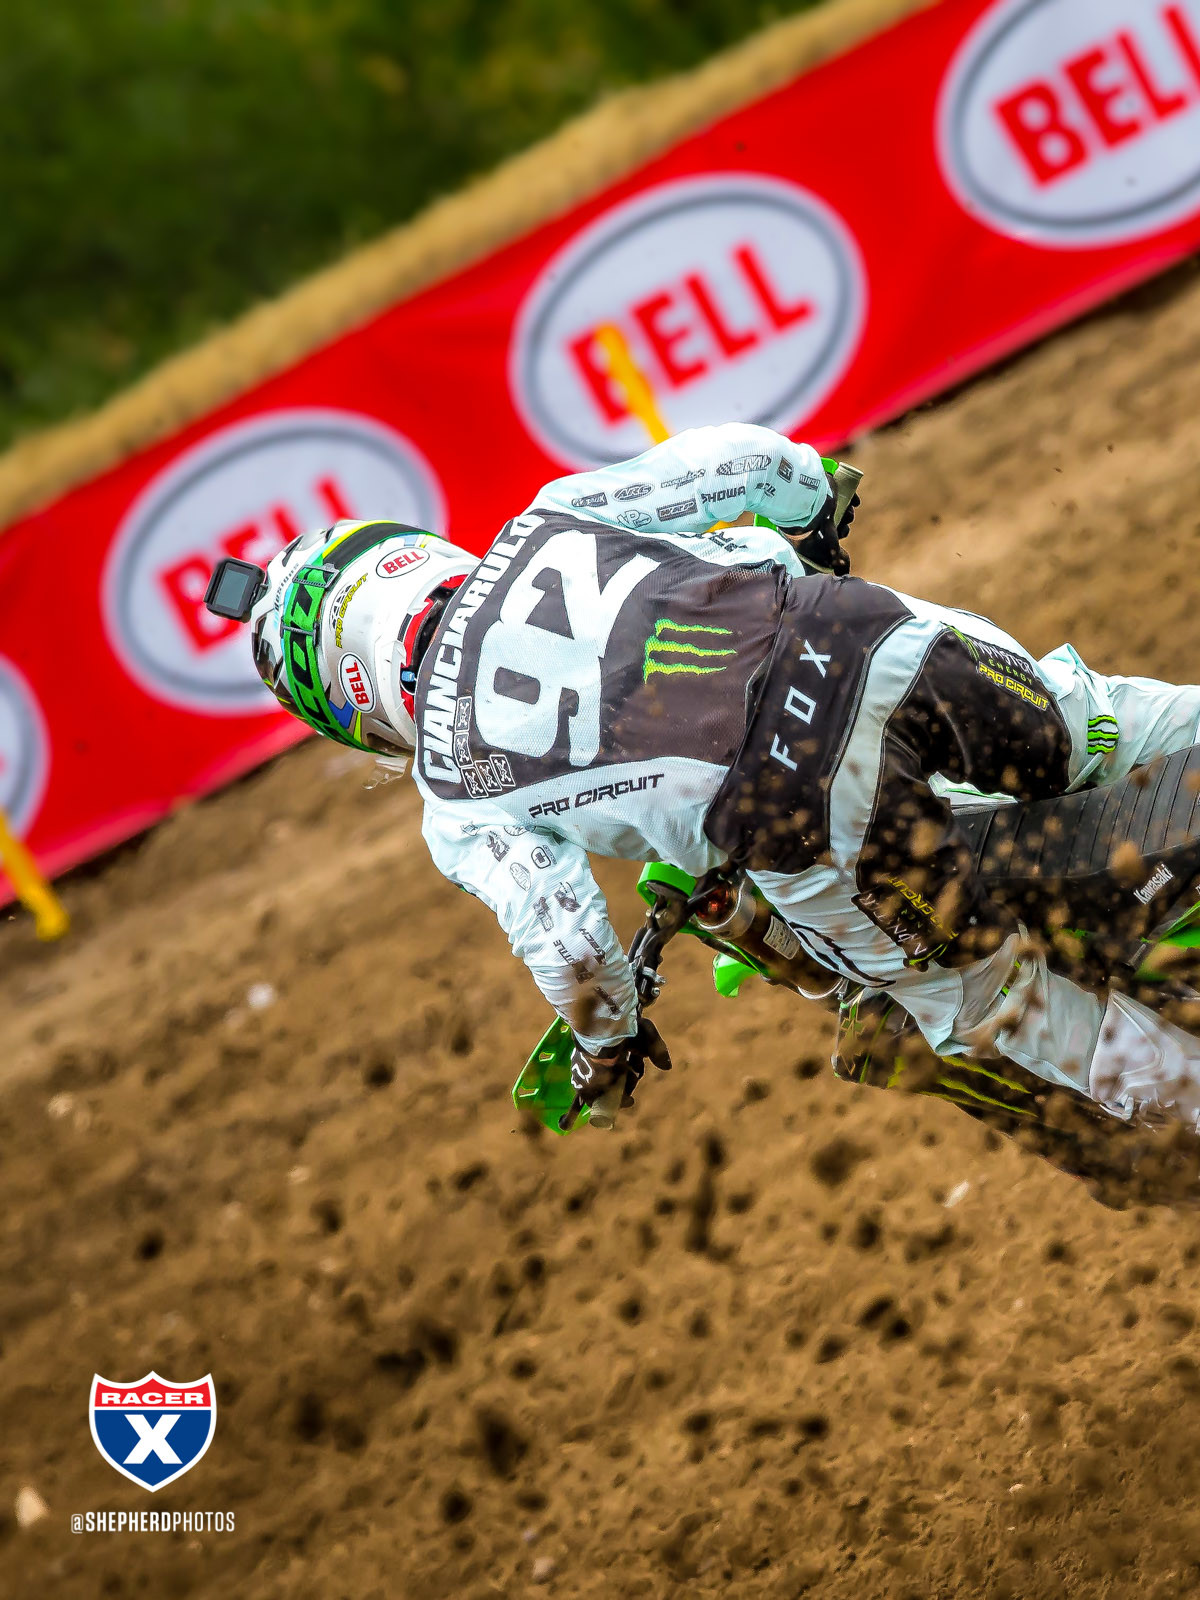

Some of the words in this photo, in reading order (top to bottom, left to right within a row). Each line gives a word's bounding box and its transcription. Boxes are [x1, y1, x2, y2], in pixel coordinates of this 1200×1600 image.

[567, 242, 813, 425] BELL
[700, 485, 746, 504] SHOWA
[382, 551, 425, 575] BELL
[418, 514, 546, 783] CIANCIARULO
[472, 529, 662, 767] 92
[346, 659, 370, 705] BELL
[979, 664, 1004, 685] PRO
[1005, 678, 1049, 709] CIRCUIT
[988, 658, 1033, 686] ENERGY
[769, 639, 834, 771] FOX
[529, 798, 571, 818] PRO
[574, 774, 664, 809] CIRCUIT
[1133, 864, 1175, 904] Kawasaki
